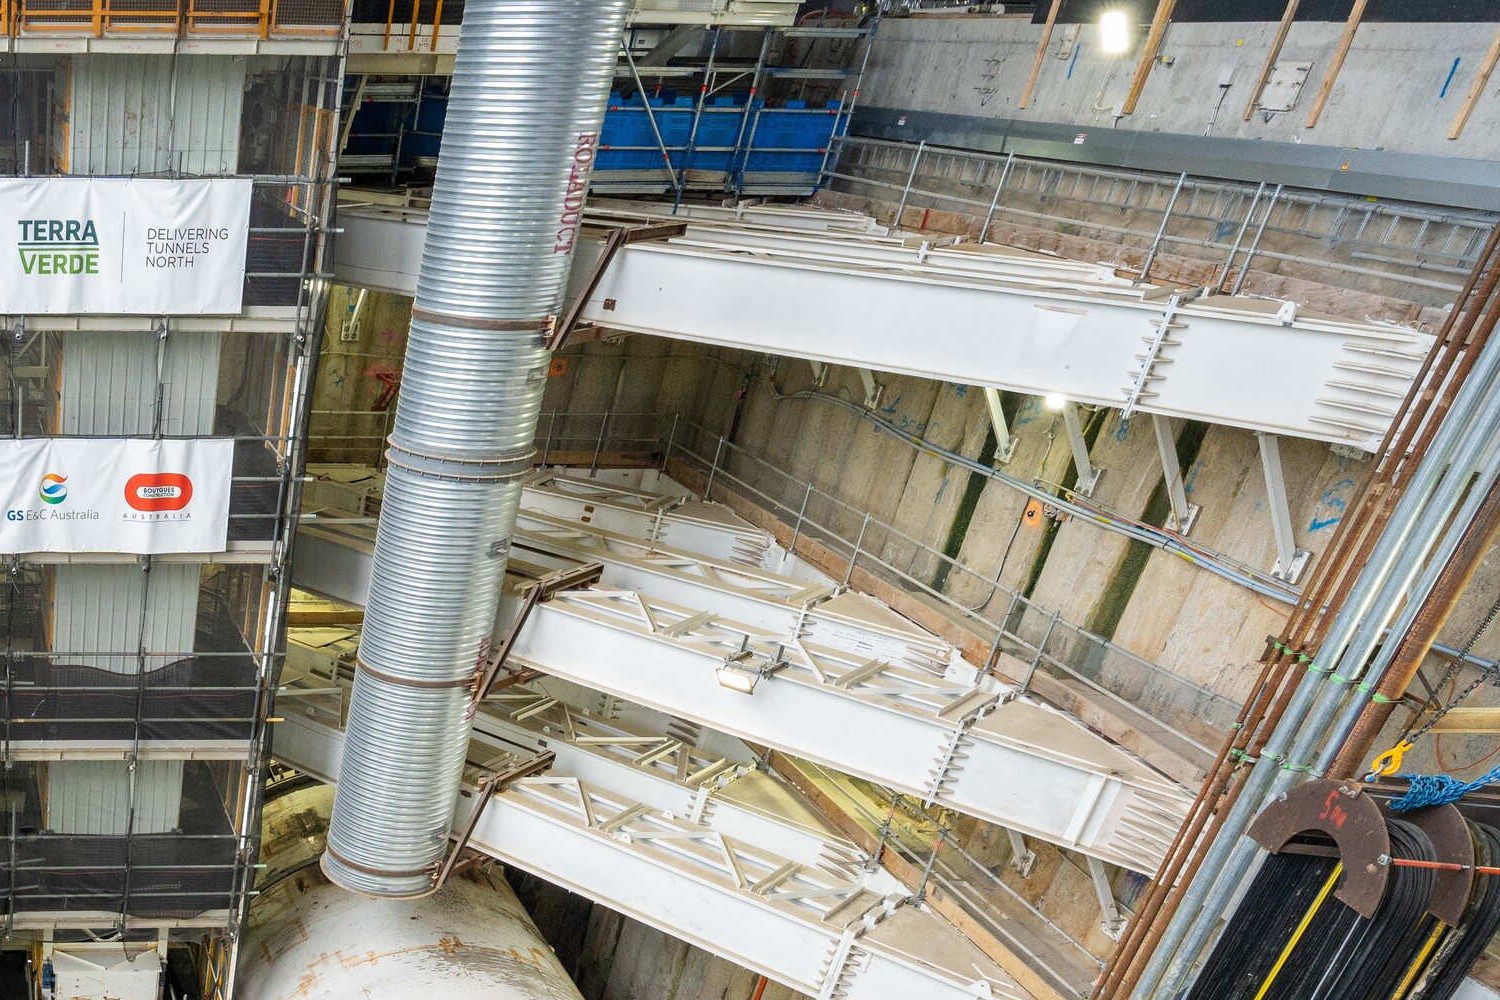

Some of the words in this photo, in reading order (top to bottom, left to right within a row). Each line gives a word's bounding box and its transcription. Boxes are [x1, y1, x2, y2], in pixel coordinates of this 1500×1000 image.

[553, 131, 597, 255] ROLADUCT
[17, 219, 99, 246] TERRA
[147, 228, 229, 241] DELIVERING
[146, 242, 210, 254] TUNNELS
[18, 248, 99, 275] VERDE
[145, 256, 194, 268] NORTH
[7, 510, 24, 521] GS
[26, 509, 48, 521] E&C
[50, 509, 99, 520] Australia
